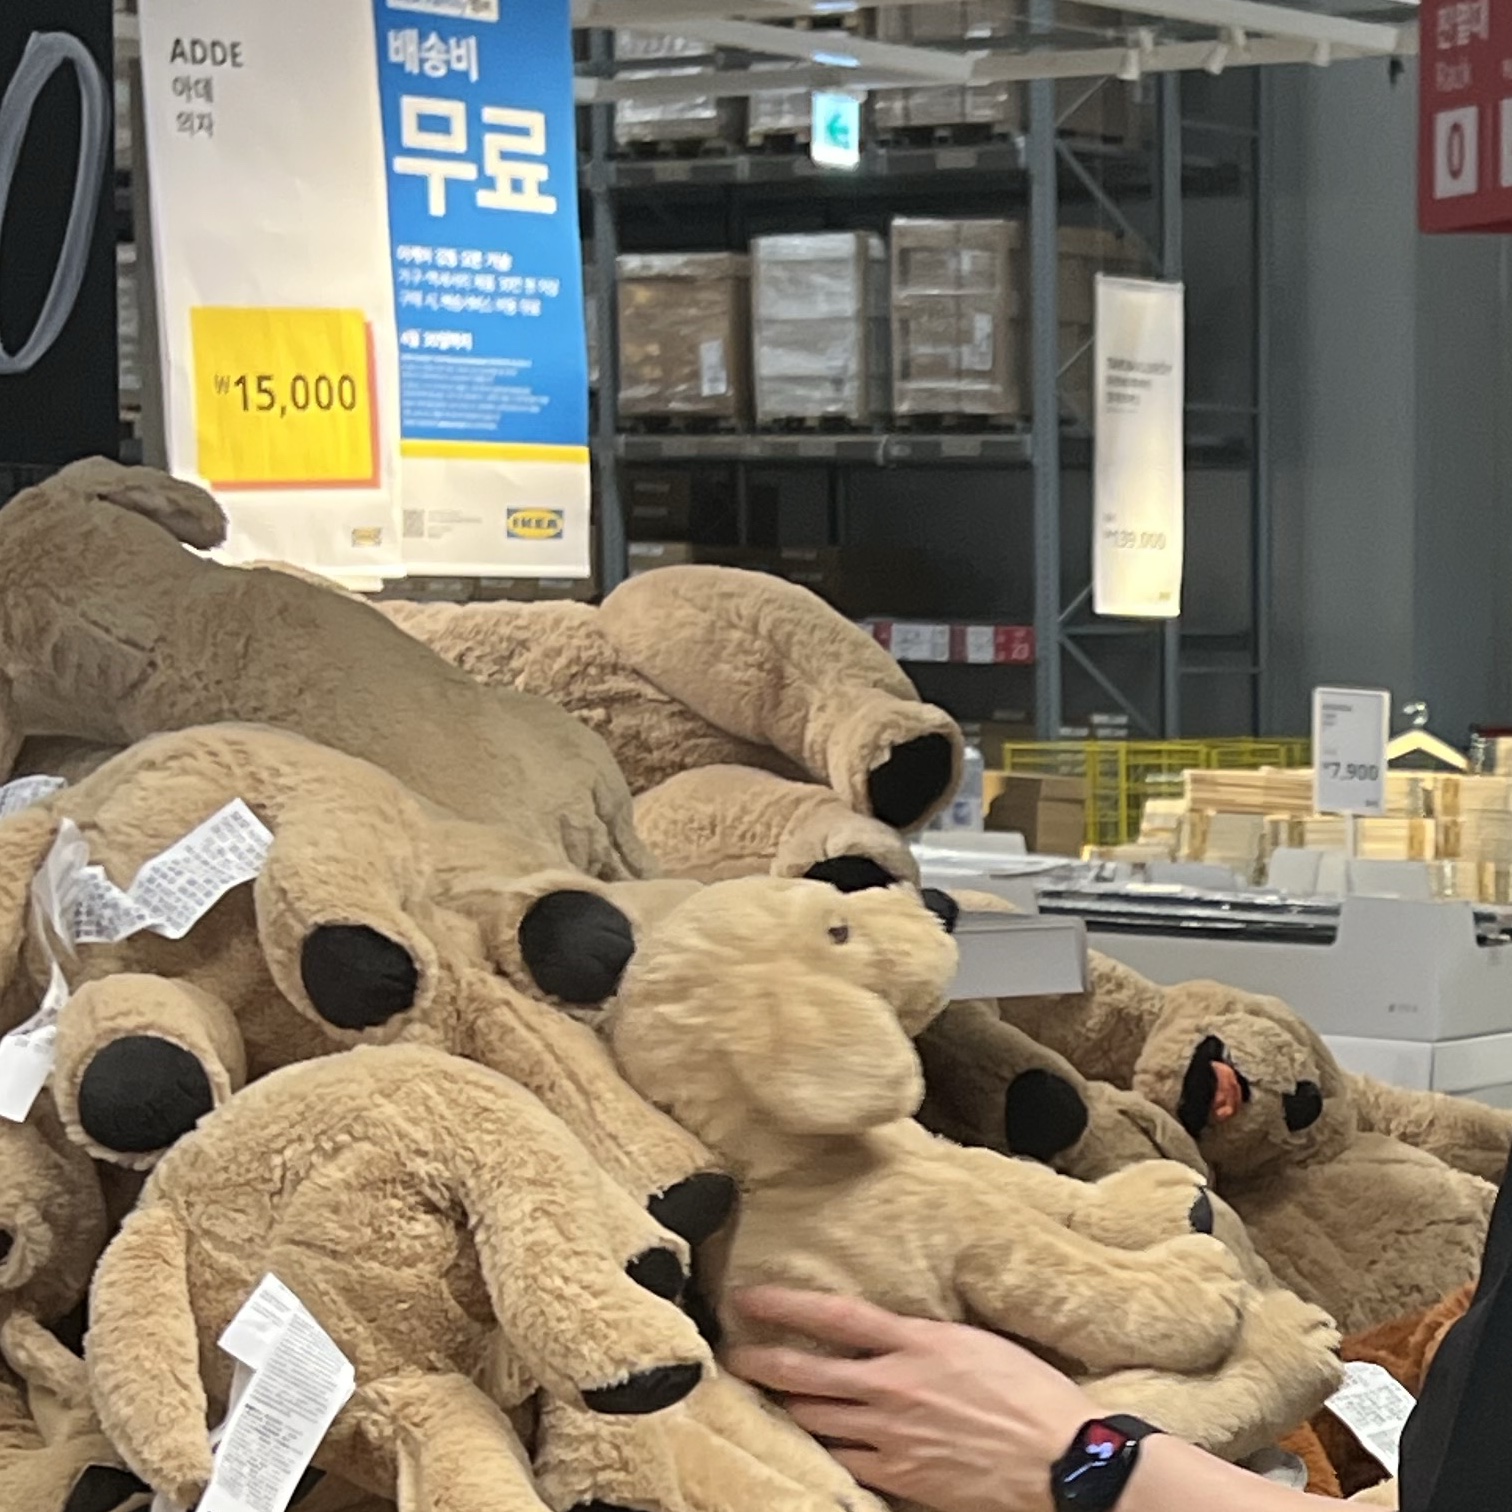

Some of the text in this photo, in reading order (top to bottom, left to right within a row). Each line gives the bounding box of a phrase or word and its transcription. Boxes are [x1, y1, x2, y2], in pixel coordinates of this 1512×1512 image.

[170, 38, 244, 67] ADDE
[386, 28, 479, 83] 배송비
[176, 111, 215, 138] 의자
[1445, 121, 1466, 180] 0
[392, 93, 559, 217] 무료
